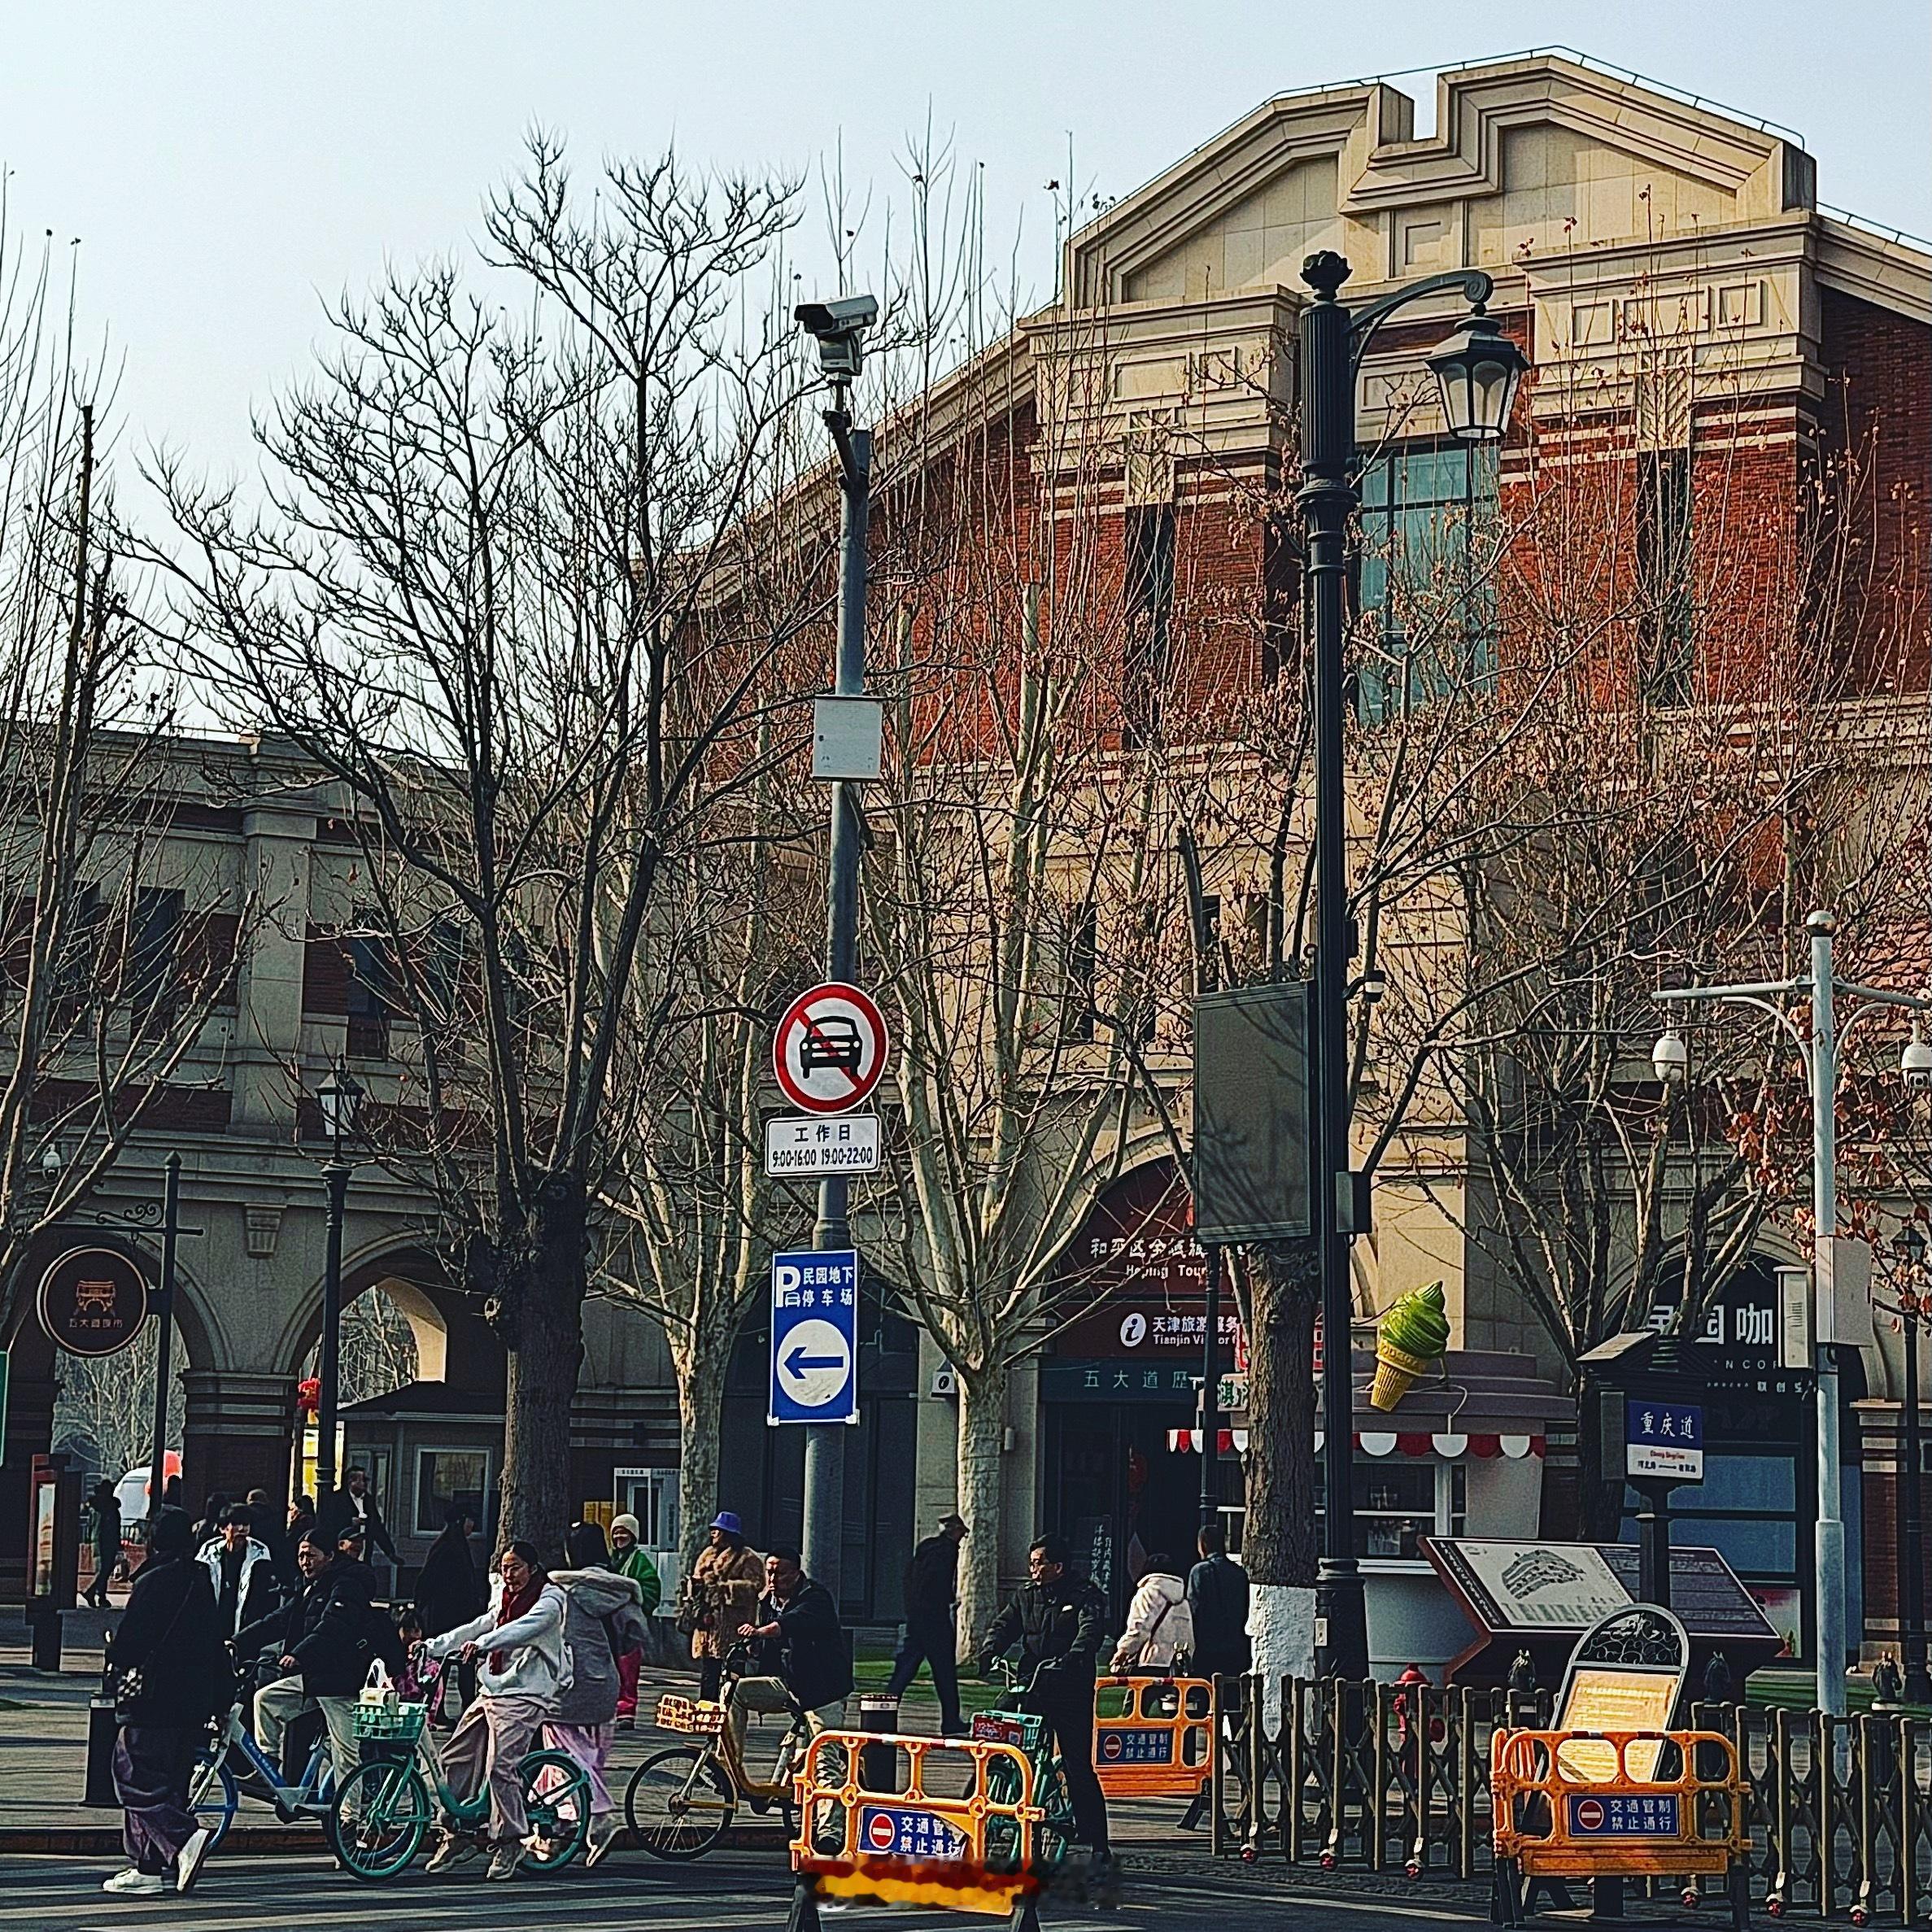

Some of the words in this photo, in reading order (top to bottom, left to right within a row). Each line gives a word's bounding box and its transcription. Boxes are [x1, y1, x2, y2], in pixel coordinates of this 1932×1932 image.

[794, 1123, 850, 1143] 工作日
[772, 1149, 817, 1167] 9:00-16:00
[821, 1146, 873, 1166] 19:00-22:00
[775, 1266, 801, 1308] P
[802, 1288, 853, 1308] 停车场
[1153, 1334, 1191, 1347] Tianjin
[1640, 1411, 1694, 1439] 重庆道
[1610, 1799, 1671, 1813] 交通管制
[901, 1816, 951, 1837] 交通管
[1611, 1816, 1671, 1830] 禁止通行
[899, 1835, 961, 1856] 禁止通行
